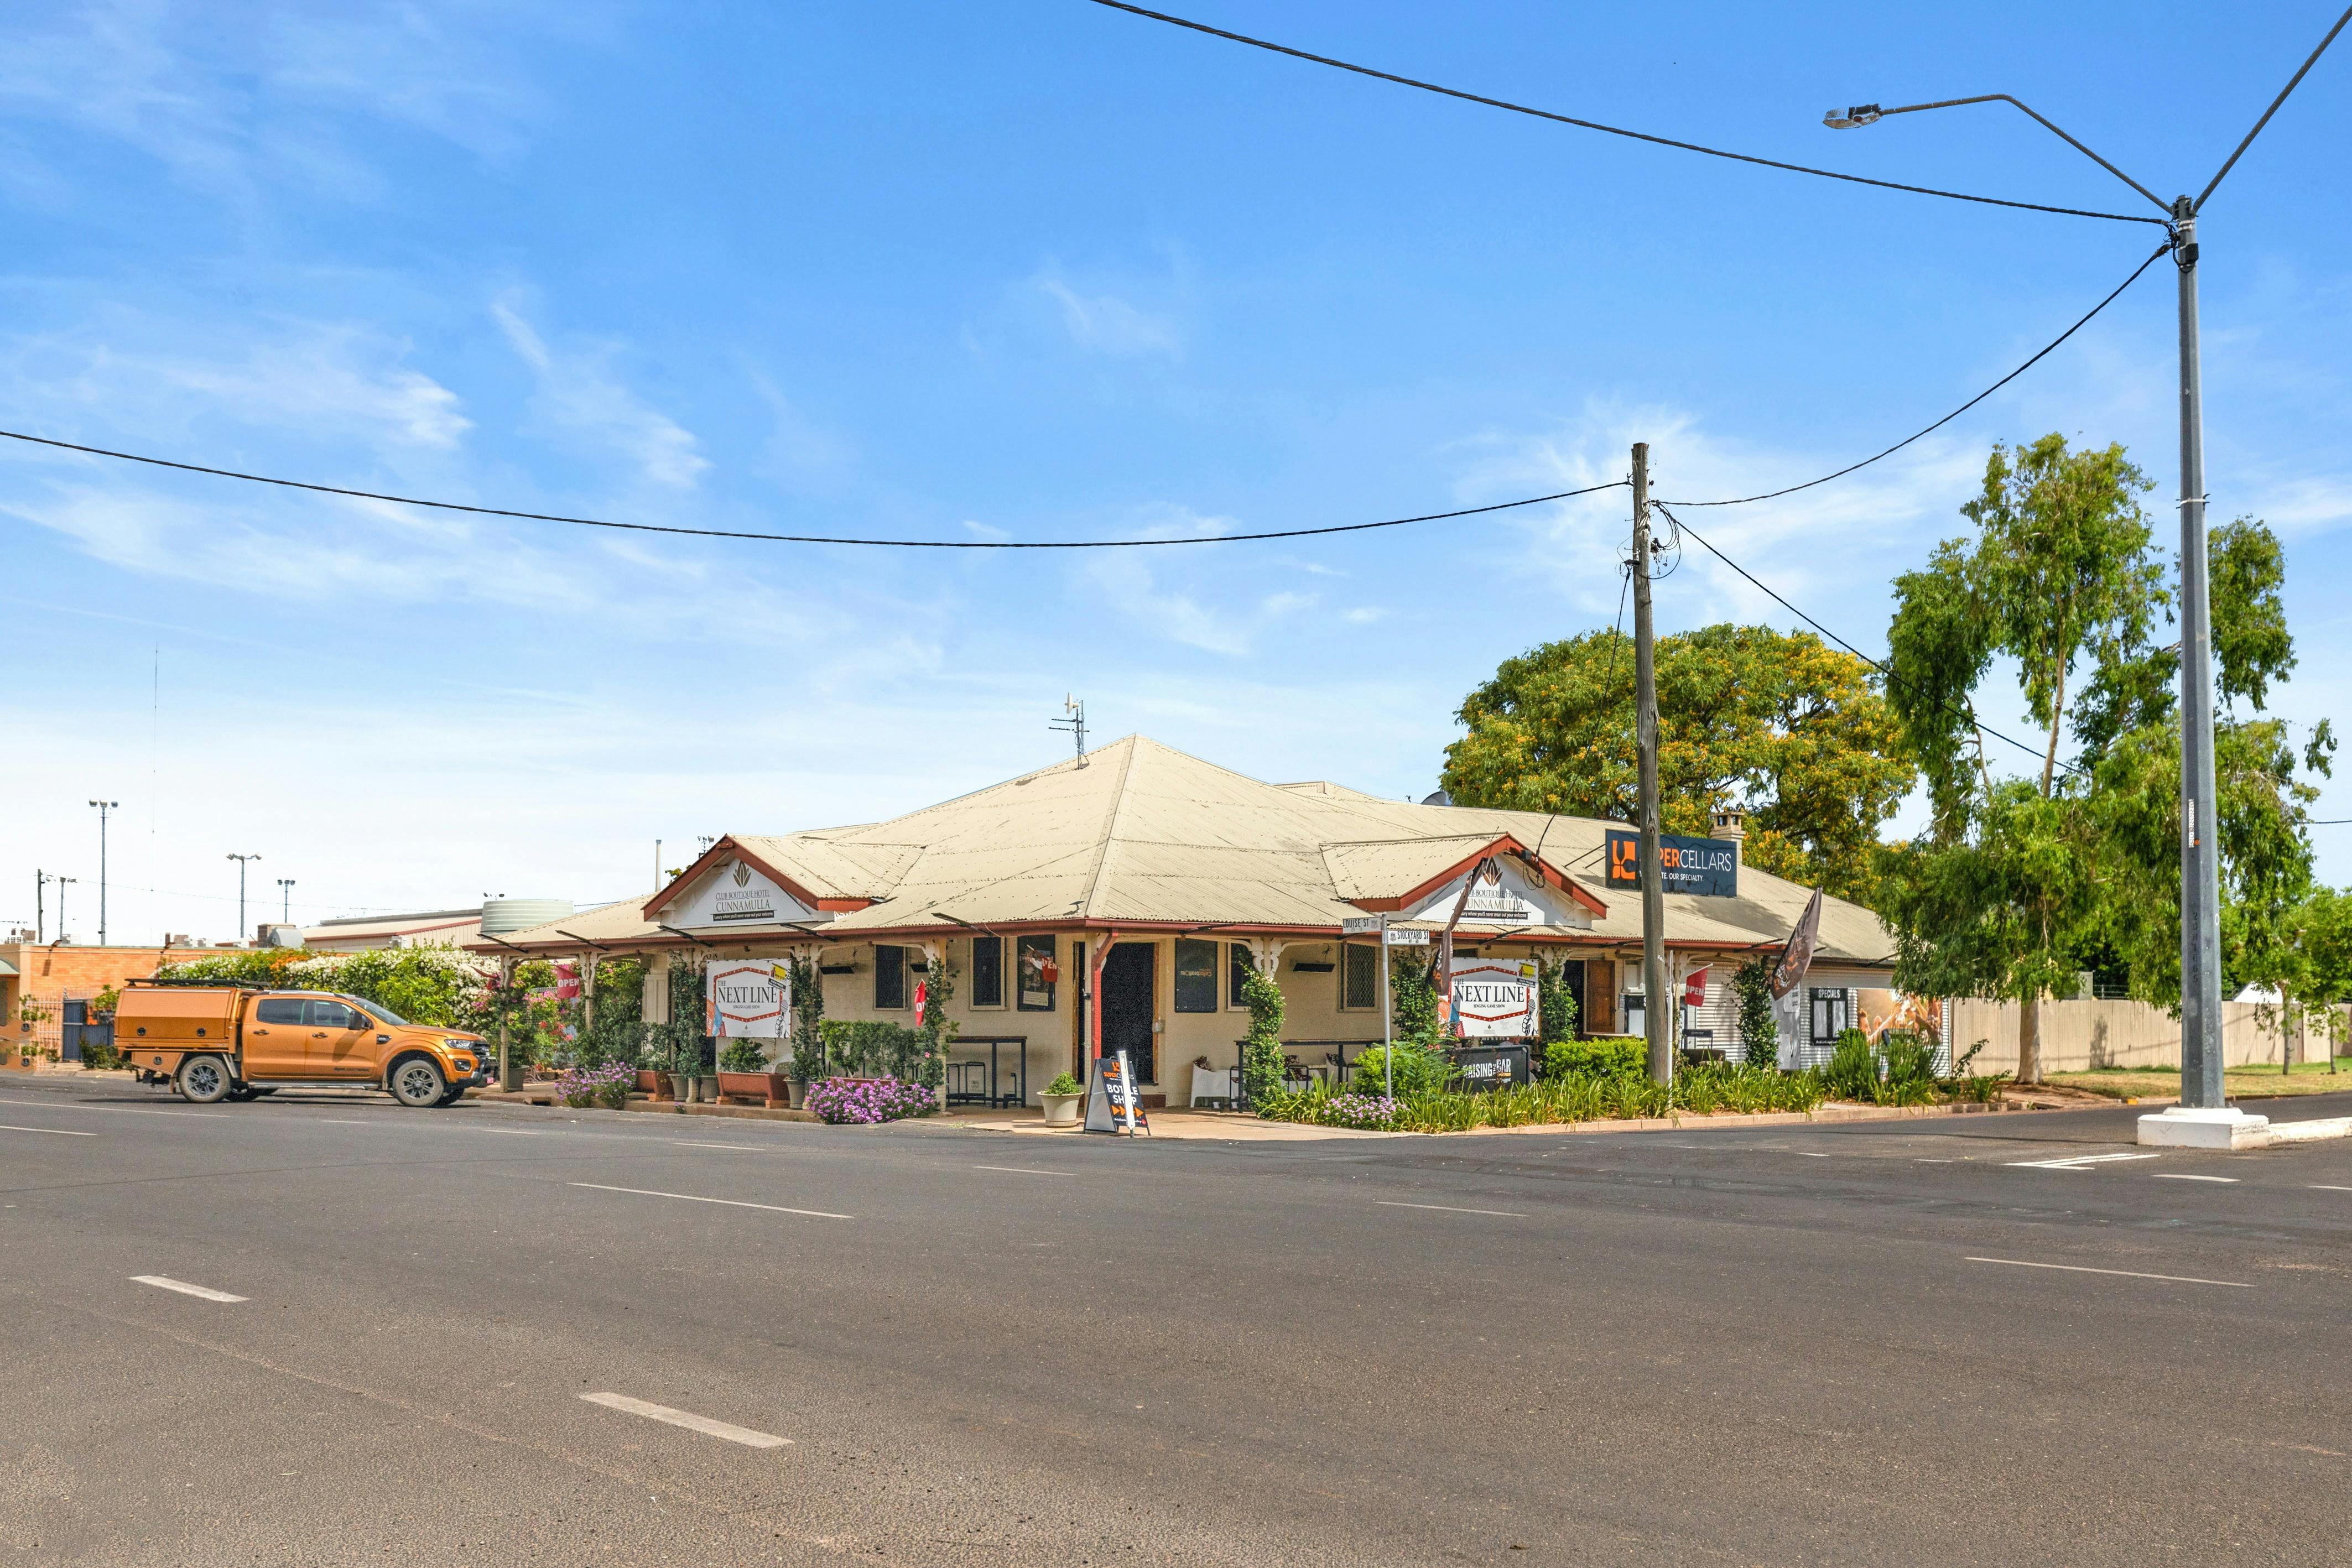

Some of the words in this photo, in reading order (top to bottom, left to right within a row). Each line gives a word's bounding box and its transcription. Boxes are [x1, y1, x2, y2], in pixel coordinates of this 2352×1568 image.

[729, 890, 753, 899] BOUTIQUE
[1476, 889, 1505, 898] BOUTIQUE
[1506, 890, 1523, 899] HOTEL
[716, 898, 771, 913] CUNNAMULLA
[1467, 898, 1523, 910] UNNAMULLA
[1342, 919, 1361, 928] LOUISE
[1363, 918, 1369, 927] ST
[1397, 930, 1422, 940] STOCKYARD
[1424, 931, 1429, 940] ST
[718, 987, 748, 1003] NEXT
[750, 987, 778, 1003] LINE
[1454, 985, 1491, 1002] NEXT
[1494, 986, 1524, 1003] LINE
[1685, 985, 1705, 996] OPEN
[1818, 989, 1840, 999] SPECIALS
[1106, 1084, 1138, 1096] BOTE
[1113, 1095, 1137, 1105] SHP
